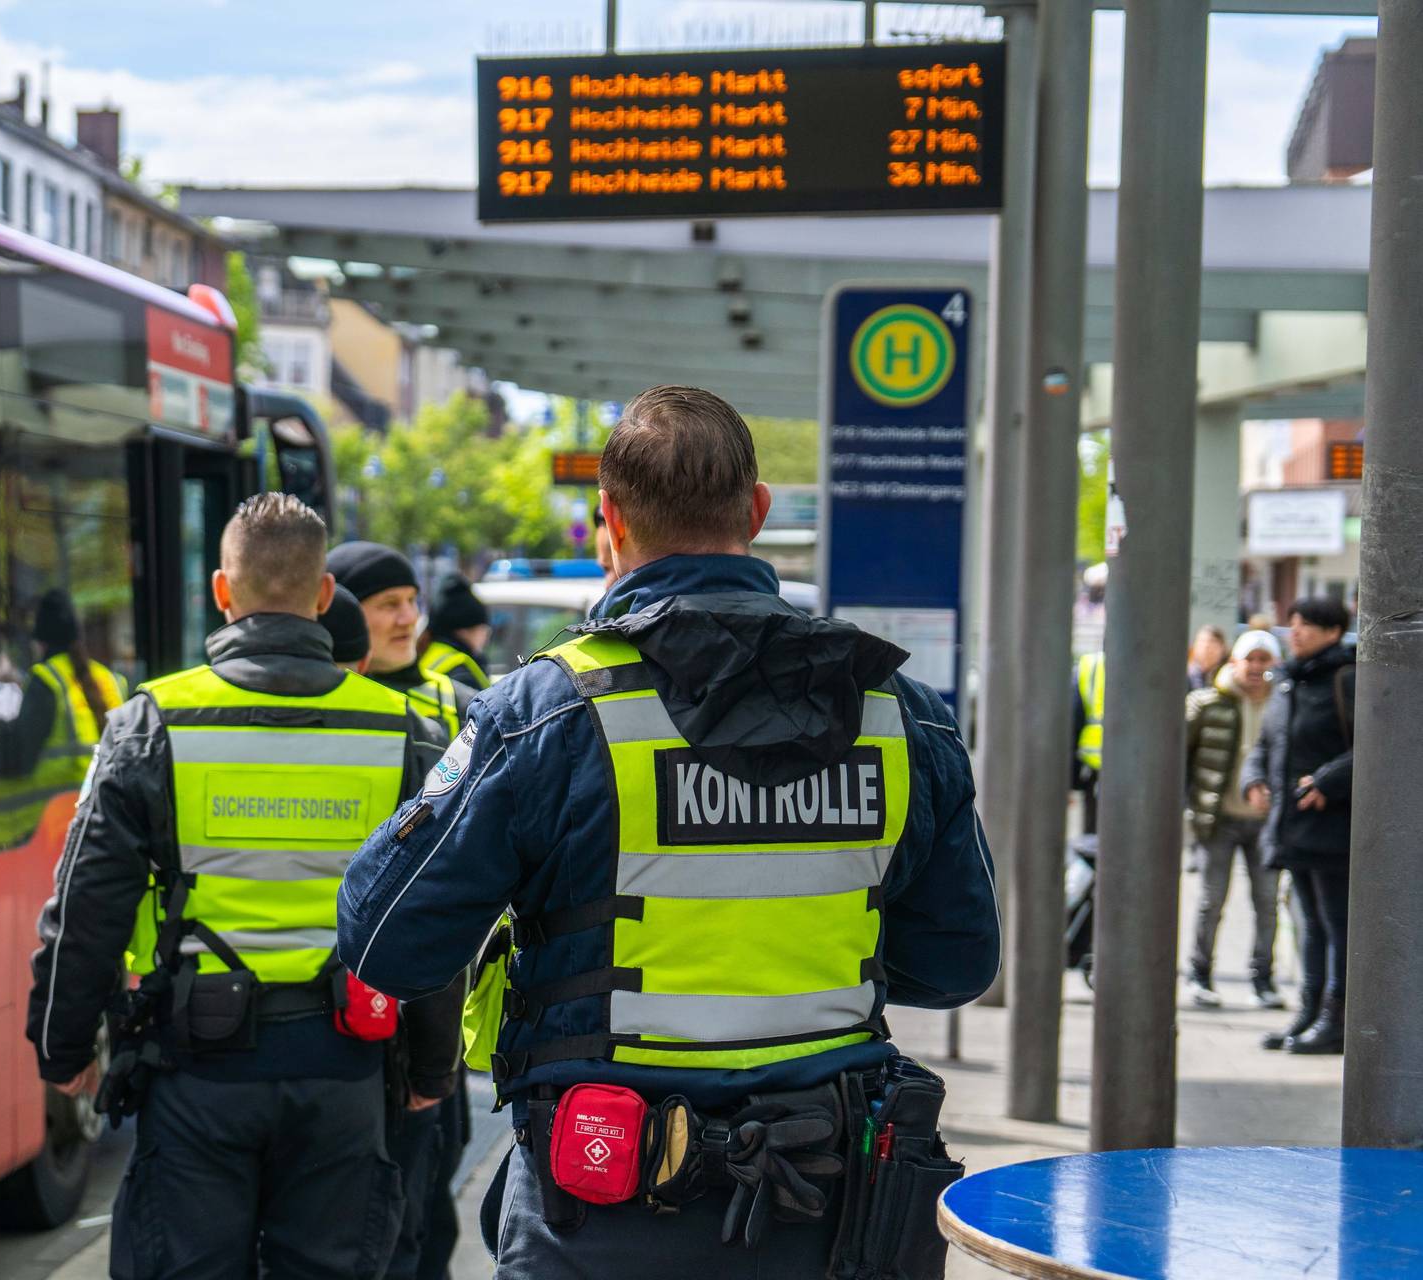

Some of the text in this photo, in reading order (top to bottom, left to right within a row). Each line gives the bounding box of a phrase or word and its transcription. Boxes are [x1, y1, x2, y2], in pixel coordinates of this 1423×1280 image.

[498, 62, 984, 101] 916 Hochheide Markt sofort
[498, 106, 553, 133] 917
[570, 103, 703, 131] Hochheide
[711, 101, 788, 127] Markt
[903, 96, 924, 121] 7
[498, 138, 553, 165] 916
[570, 136, 703, 163] Hochheide
[711, 133, 788, 159] Markt
[889, 129, 923, 154] 27
[498, 170, 553, 197] 917
[570, 168, 703, 194] Hochheide
[711, 165, 788, 191] Markt
[887, 161, 923, 187] 36
[940, 292, 967, 328] 4
[884, 334, 921, 377] H
[212, 796, 361, 820] SICHERHEITSDIENST
[676, 763, 879, 825] KONTROLLE
[580, 1124, 598, 1132] FIRST
